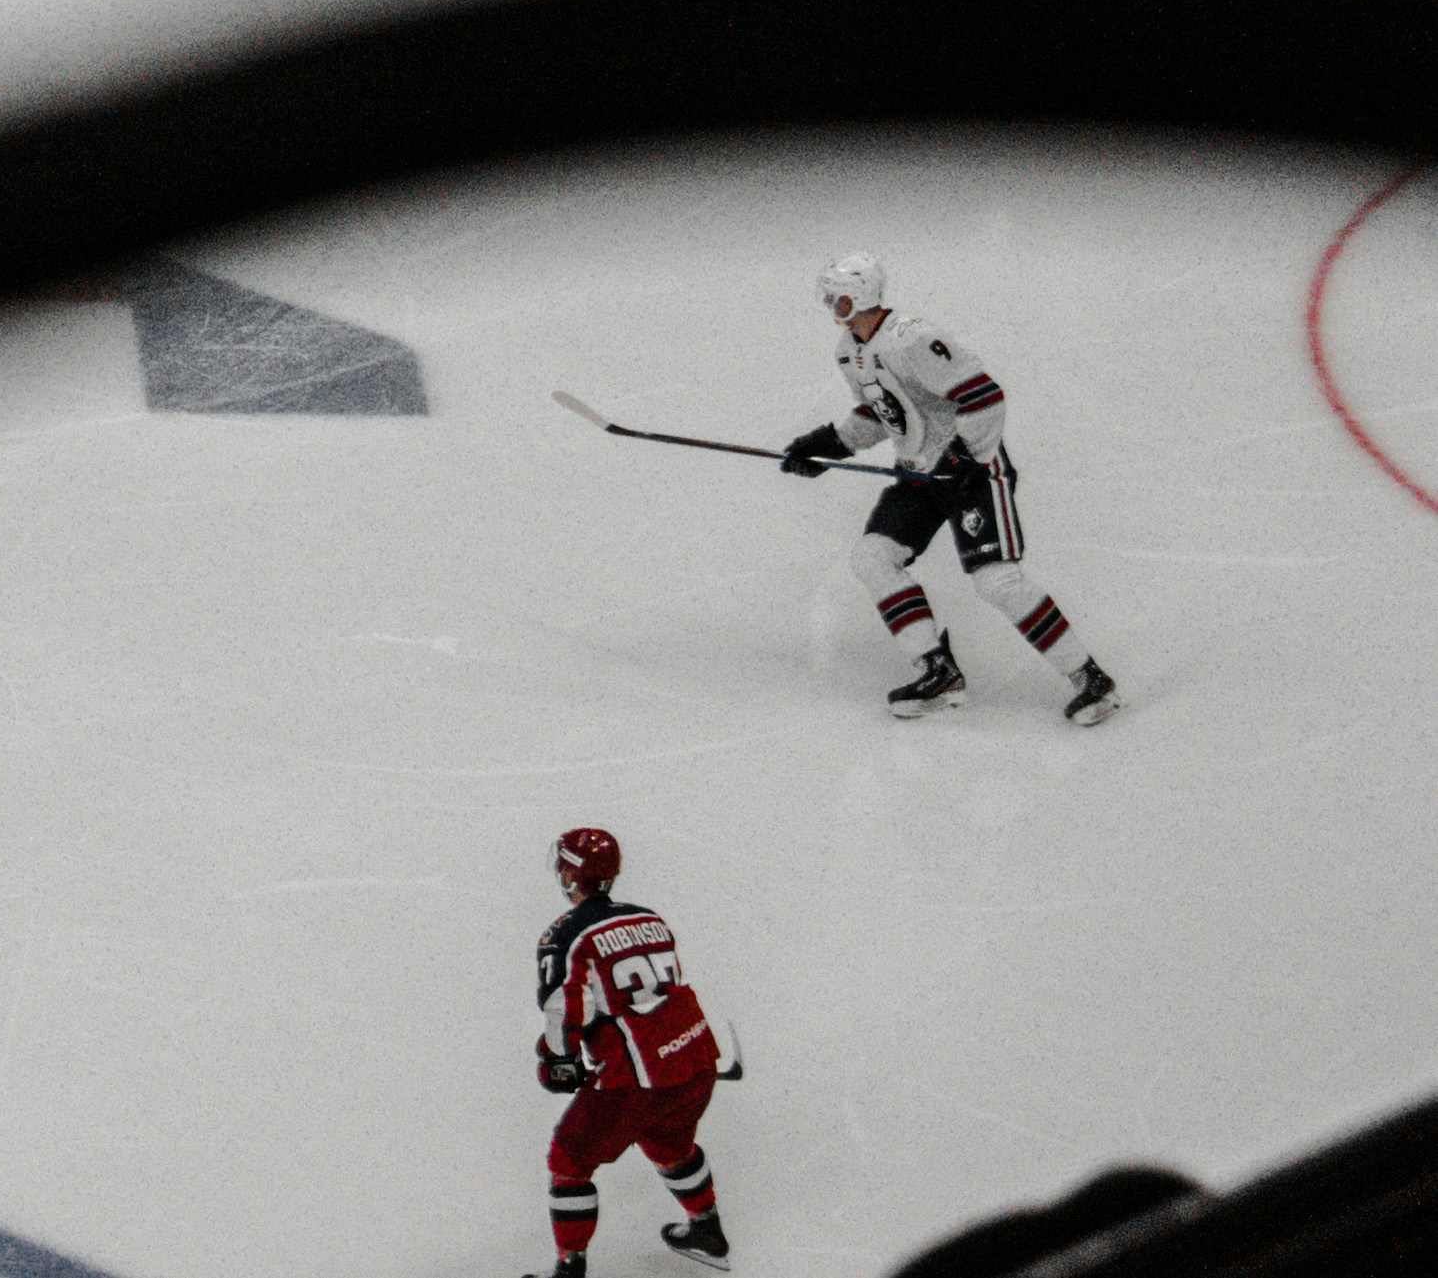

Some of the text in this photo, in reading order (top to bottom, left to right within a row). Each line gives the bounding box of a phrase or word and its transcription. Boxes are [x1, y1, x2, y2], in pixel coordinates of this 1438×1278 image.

[929, 339, 952, 361] 9
[592, 920, 672, 957] ROBINSON
[612, 951, 681, 1014] 37
